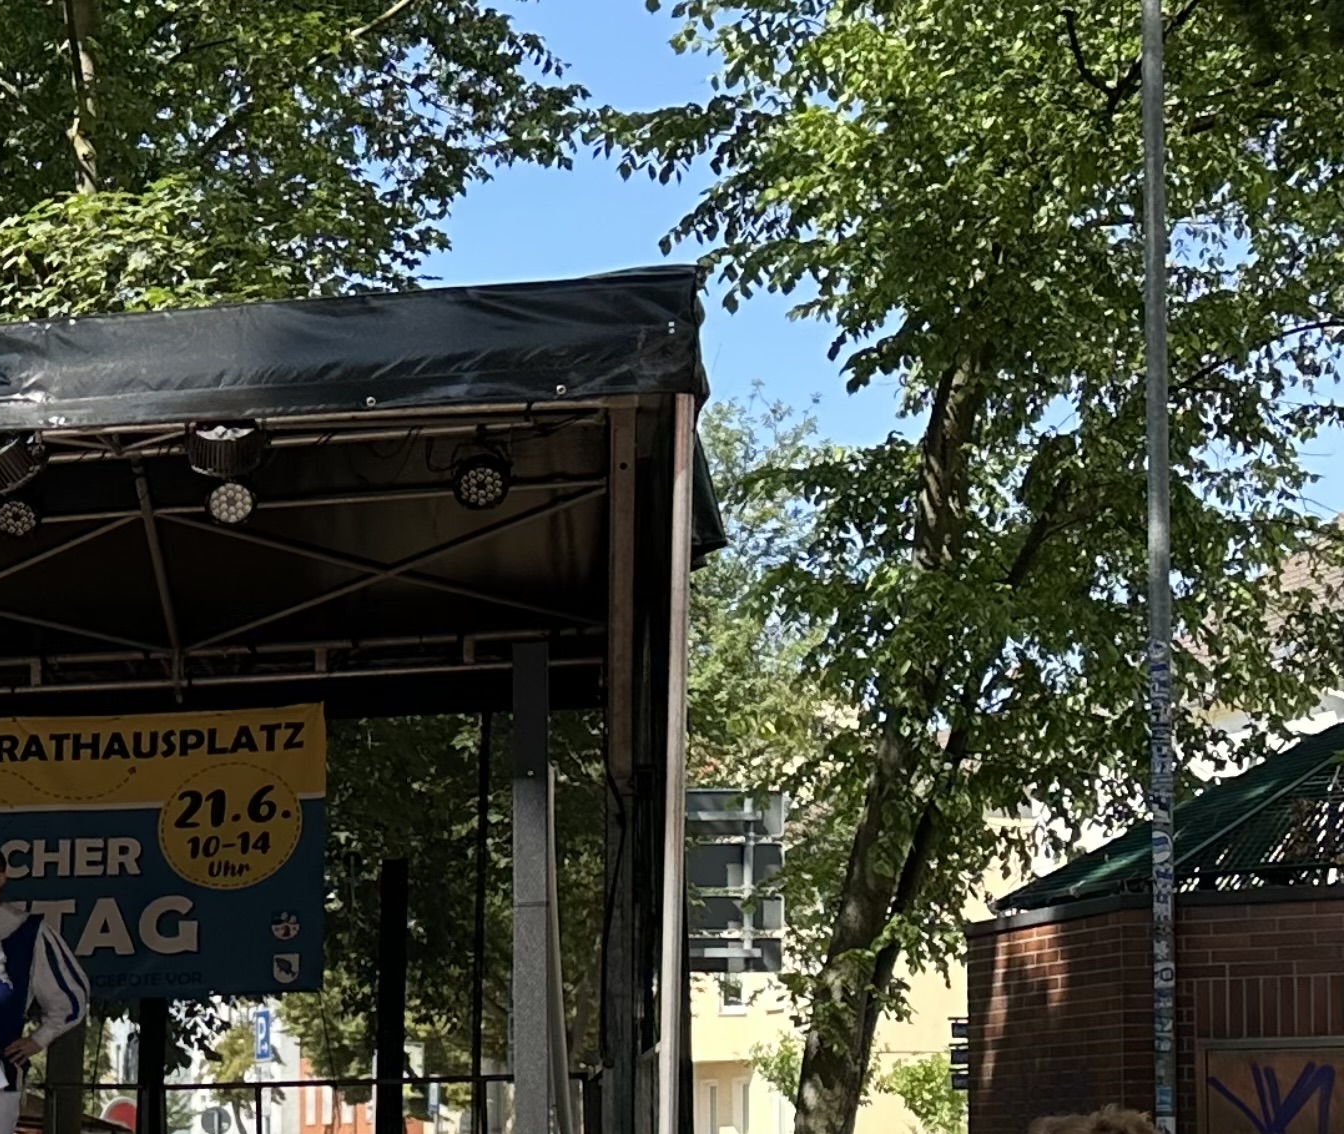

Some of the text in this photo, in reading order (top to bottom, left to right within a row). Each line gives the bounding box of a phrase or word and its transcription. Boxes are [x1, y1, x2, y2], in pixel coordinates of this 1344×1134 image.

[172, 785, 292, 830] 21.6.
[185, 834, 272, 859] 10-14
[207, 857, 252, 880] Uhr
